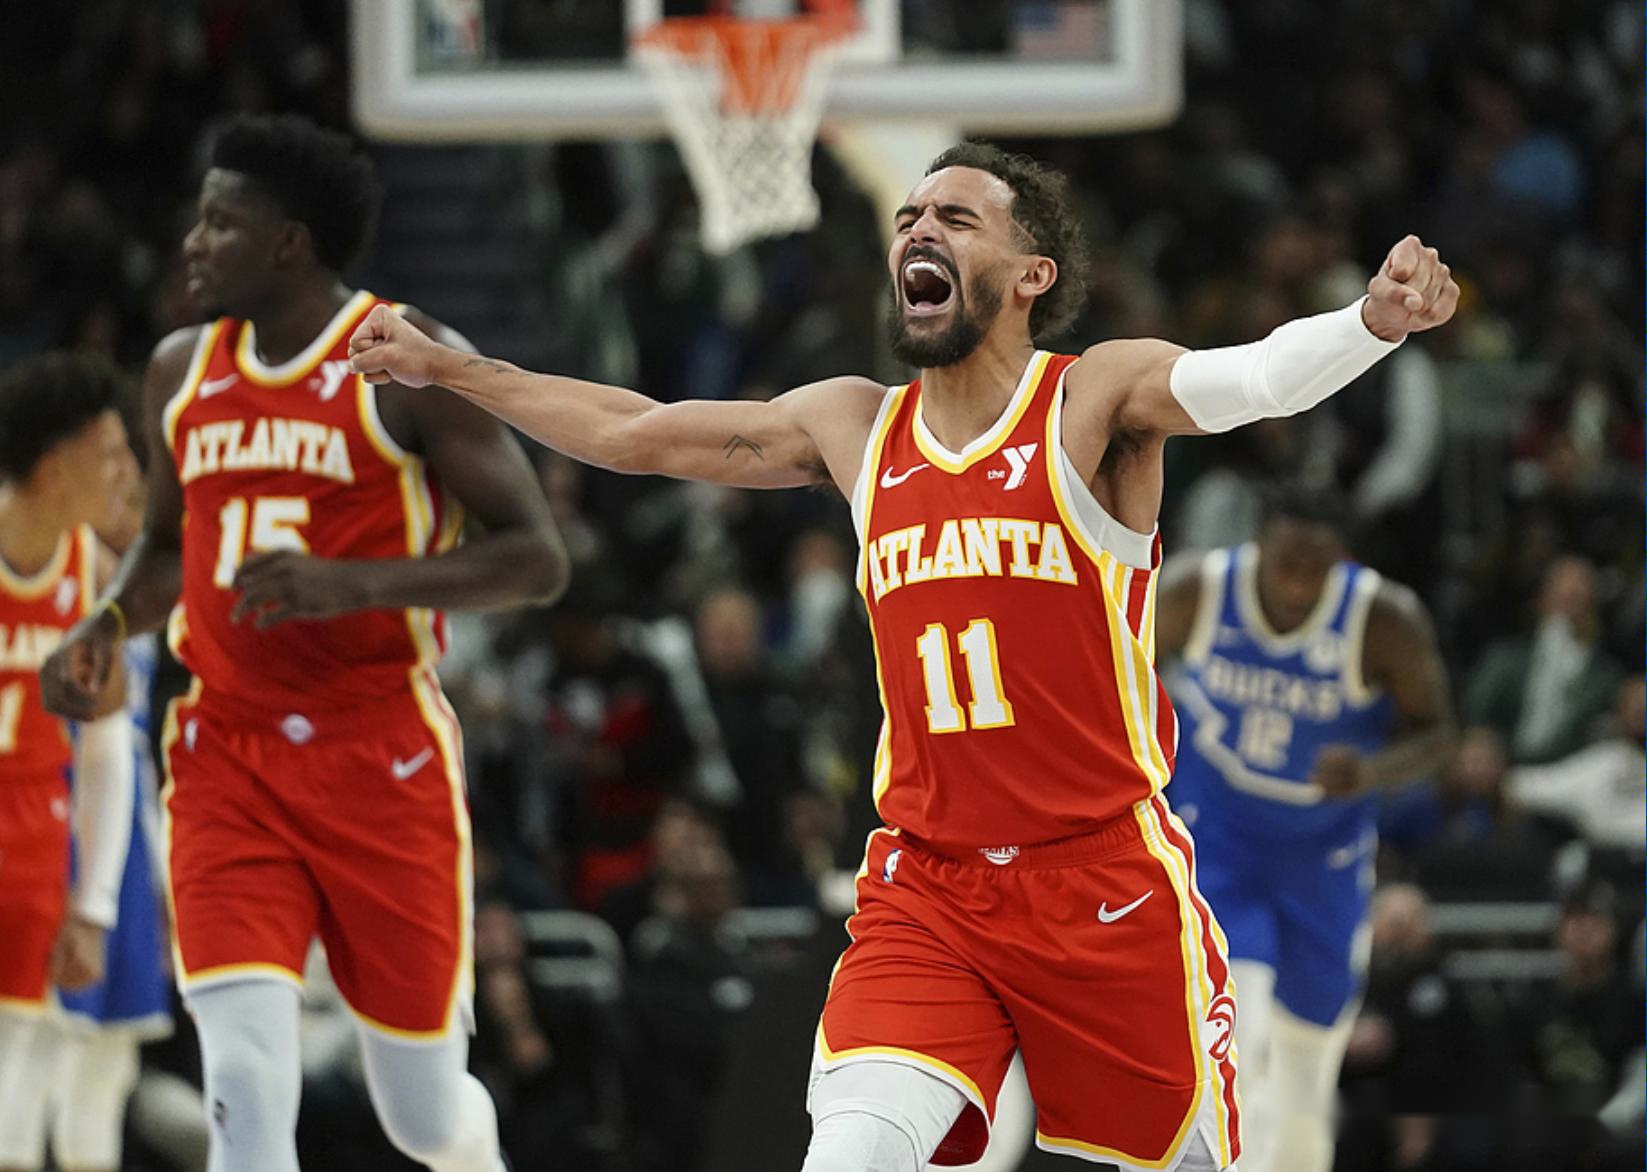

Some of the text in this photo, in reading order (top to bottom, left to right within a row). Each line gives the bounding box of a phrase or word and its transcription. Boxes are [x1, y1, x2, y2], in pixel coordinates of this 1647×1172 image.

[179, 416, 355, 486] ATLANTA
[212, 496, 312, 590] 15
[867, 516, 1079, 606] ATLANTA
[915, 617, 1017, 734] 11
[1205, 653, 1344, 722] BUCKS
[1239, 705, 1293, 770] 12
